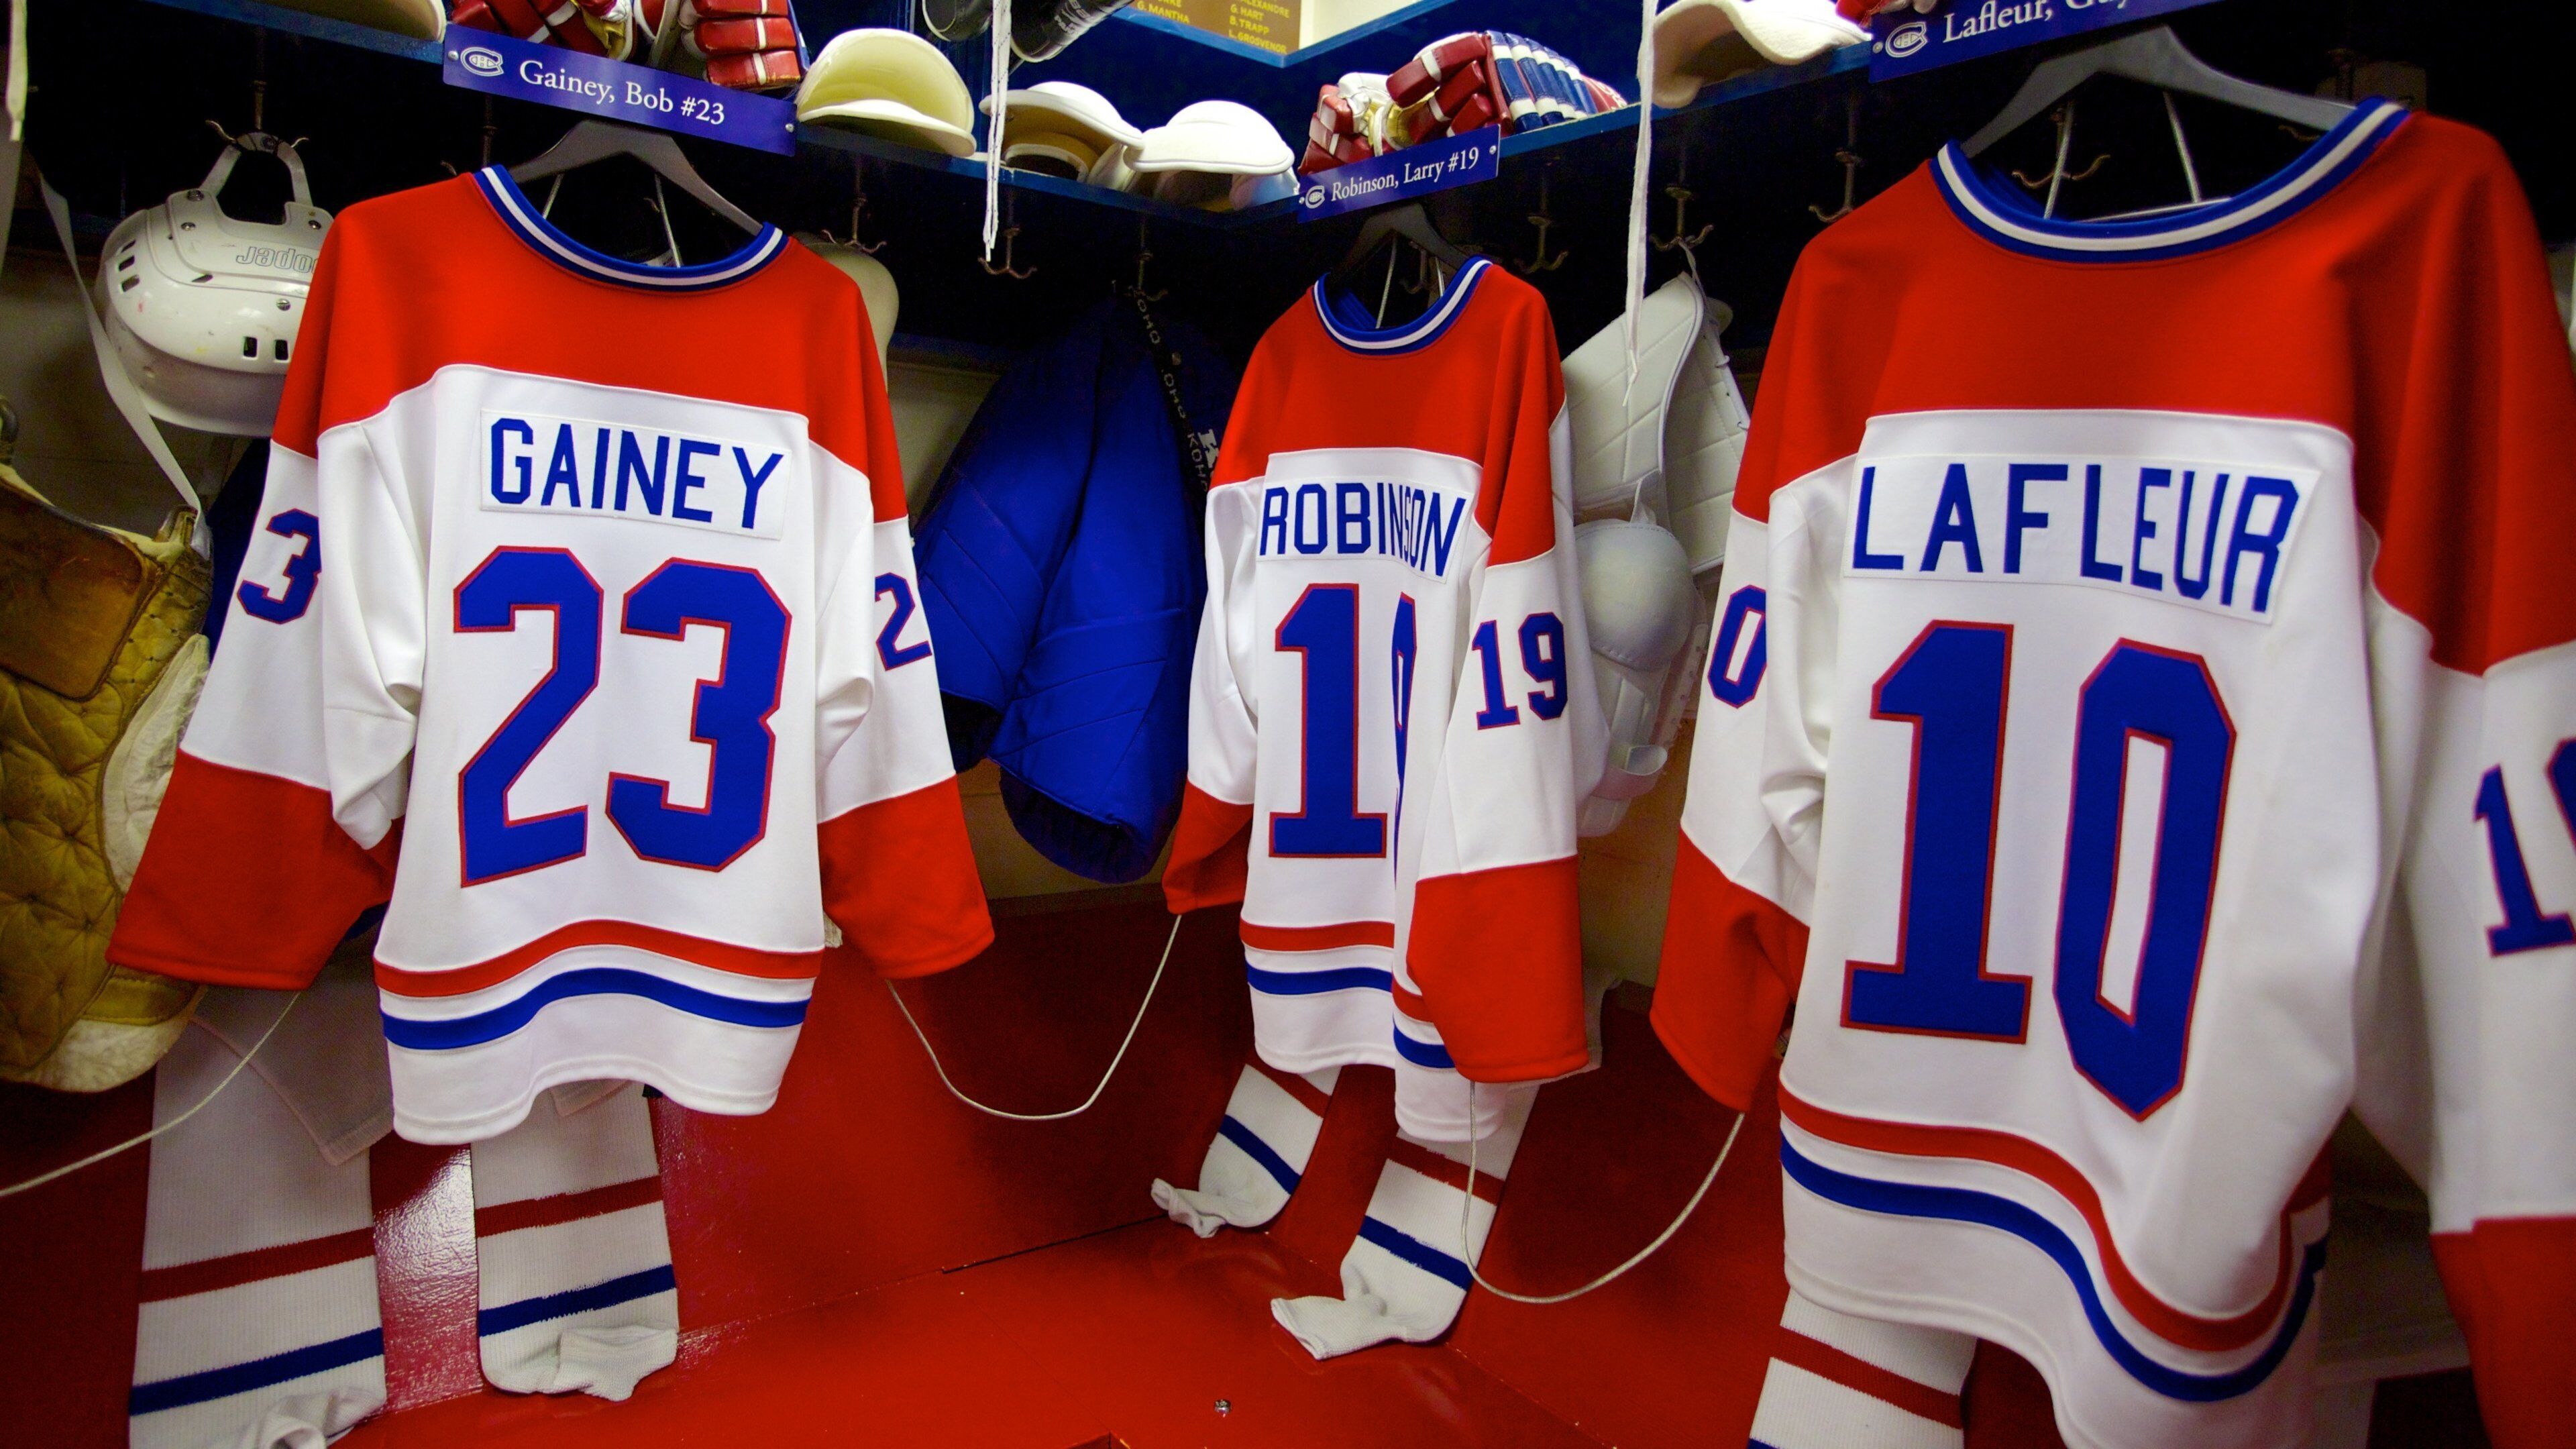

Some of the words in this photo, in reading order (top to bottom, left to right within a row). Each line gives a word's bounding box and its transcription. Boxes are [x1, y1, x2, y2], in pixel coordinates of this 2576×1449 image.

[1148, 3, 1189, 24] MANTHA
[1238, 32, 1287, 56] GROSVENOR
[1239, 19, 1270, 35] TRAPP
[1241, 6, 1265, 21] HART
[1943, 0, 2053, 43] Lafleur,
[519, 59, 615, 107] Gainey,
[625, 81, 674, 113] Bob
[681, 96, 725, 125] #23
[1331, 175, 1399, 202] Robinson,
[1403, 160, 1444, 184] Larry
[1448, 146, 1479, 172] #19
[235, 246, 319, 274] Jado
[491, 417, 784, 530] GAINEY
[237, 508, 322, 625] 3
[1259, 482, 1466, 577] ROBINSON
[1851, 463, 2300, 613] LAFLEUR
[875, 572, 932, 671] 2
[1708, 585, 1766, 708] 0
[453, 545, 793, 888] 23
[1472, 612, 1567, 731] 19
[1840, 619, 2237, 1123] 10
